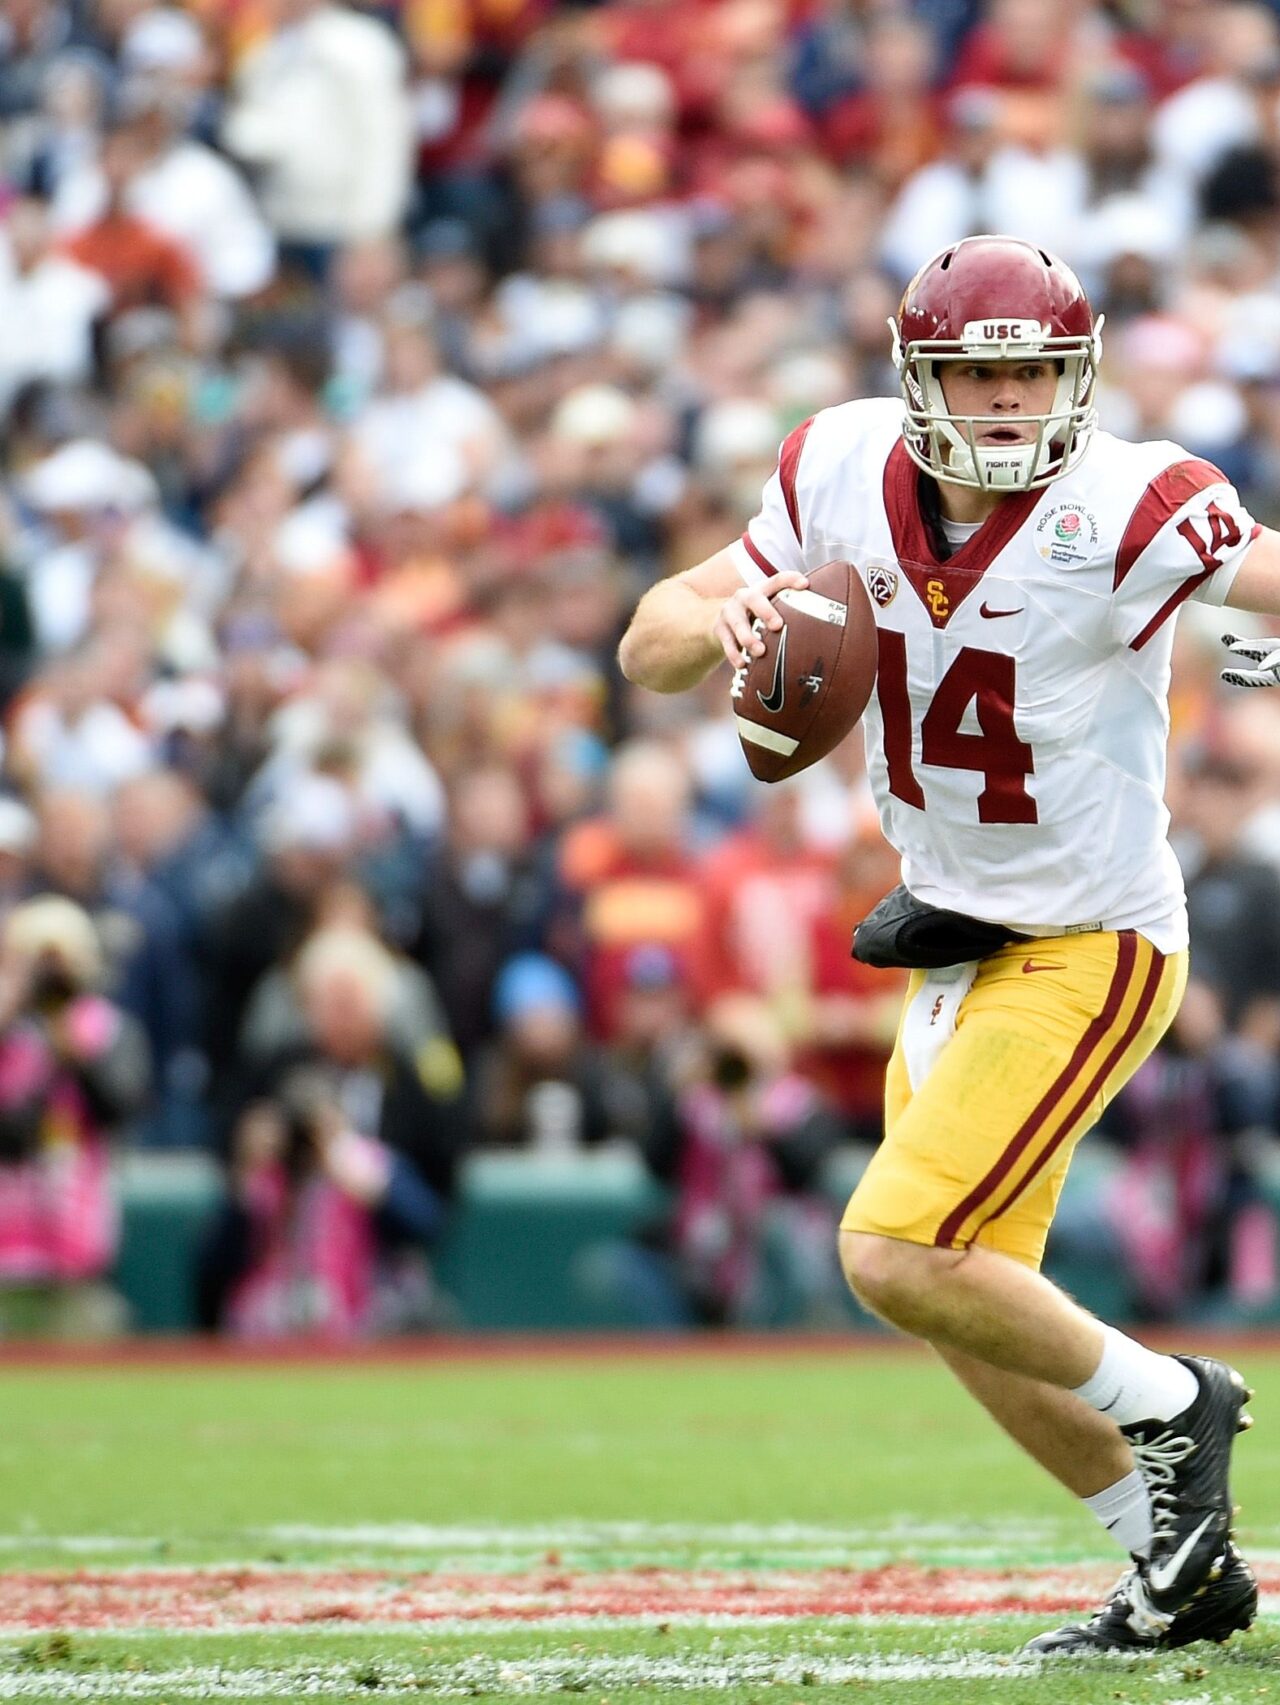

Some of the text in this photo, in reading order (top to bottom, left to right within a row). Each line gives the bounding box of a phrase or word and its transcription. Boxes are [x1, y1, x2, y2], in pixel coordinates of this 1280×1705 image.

[983, 324, 1021, 339] USC
[1036, 504, 1098, 544] ROSE BOWL GAME
[1176, 500, 1244, 565] 14
[867, 568, 897, 594] PAC
[874, 584, 890, 601] 12
[927, 580, 949, 617] SC
[877, 626, 1039, 824] 14
